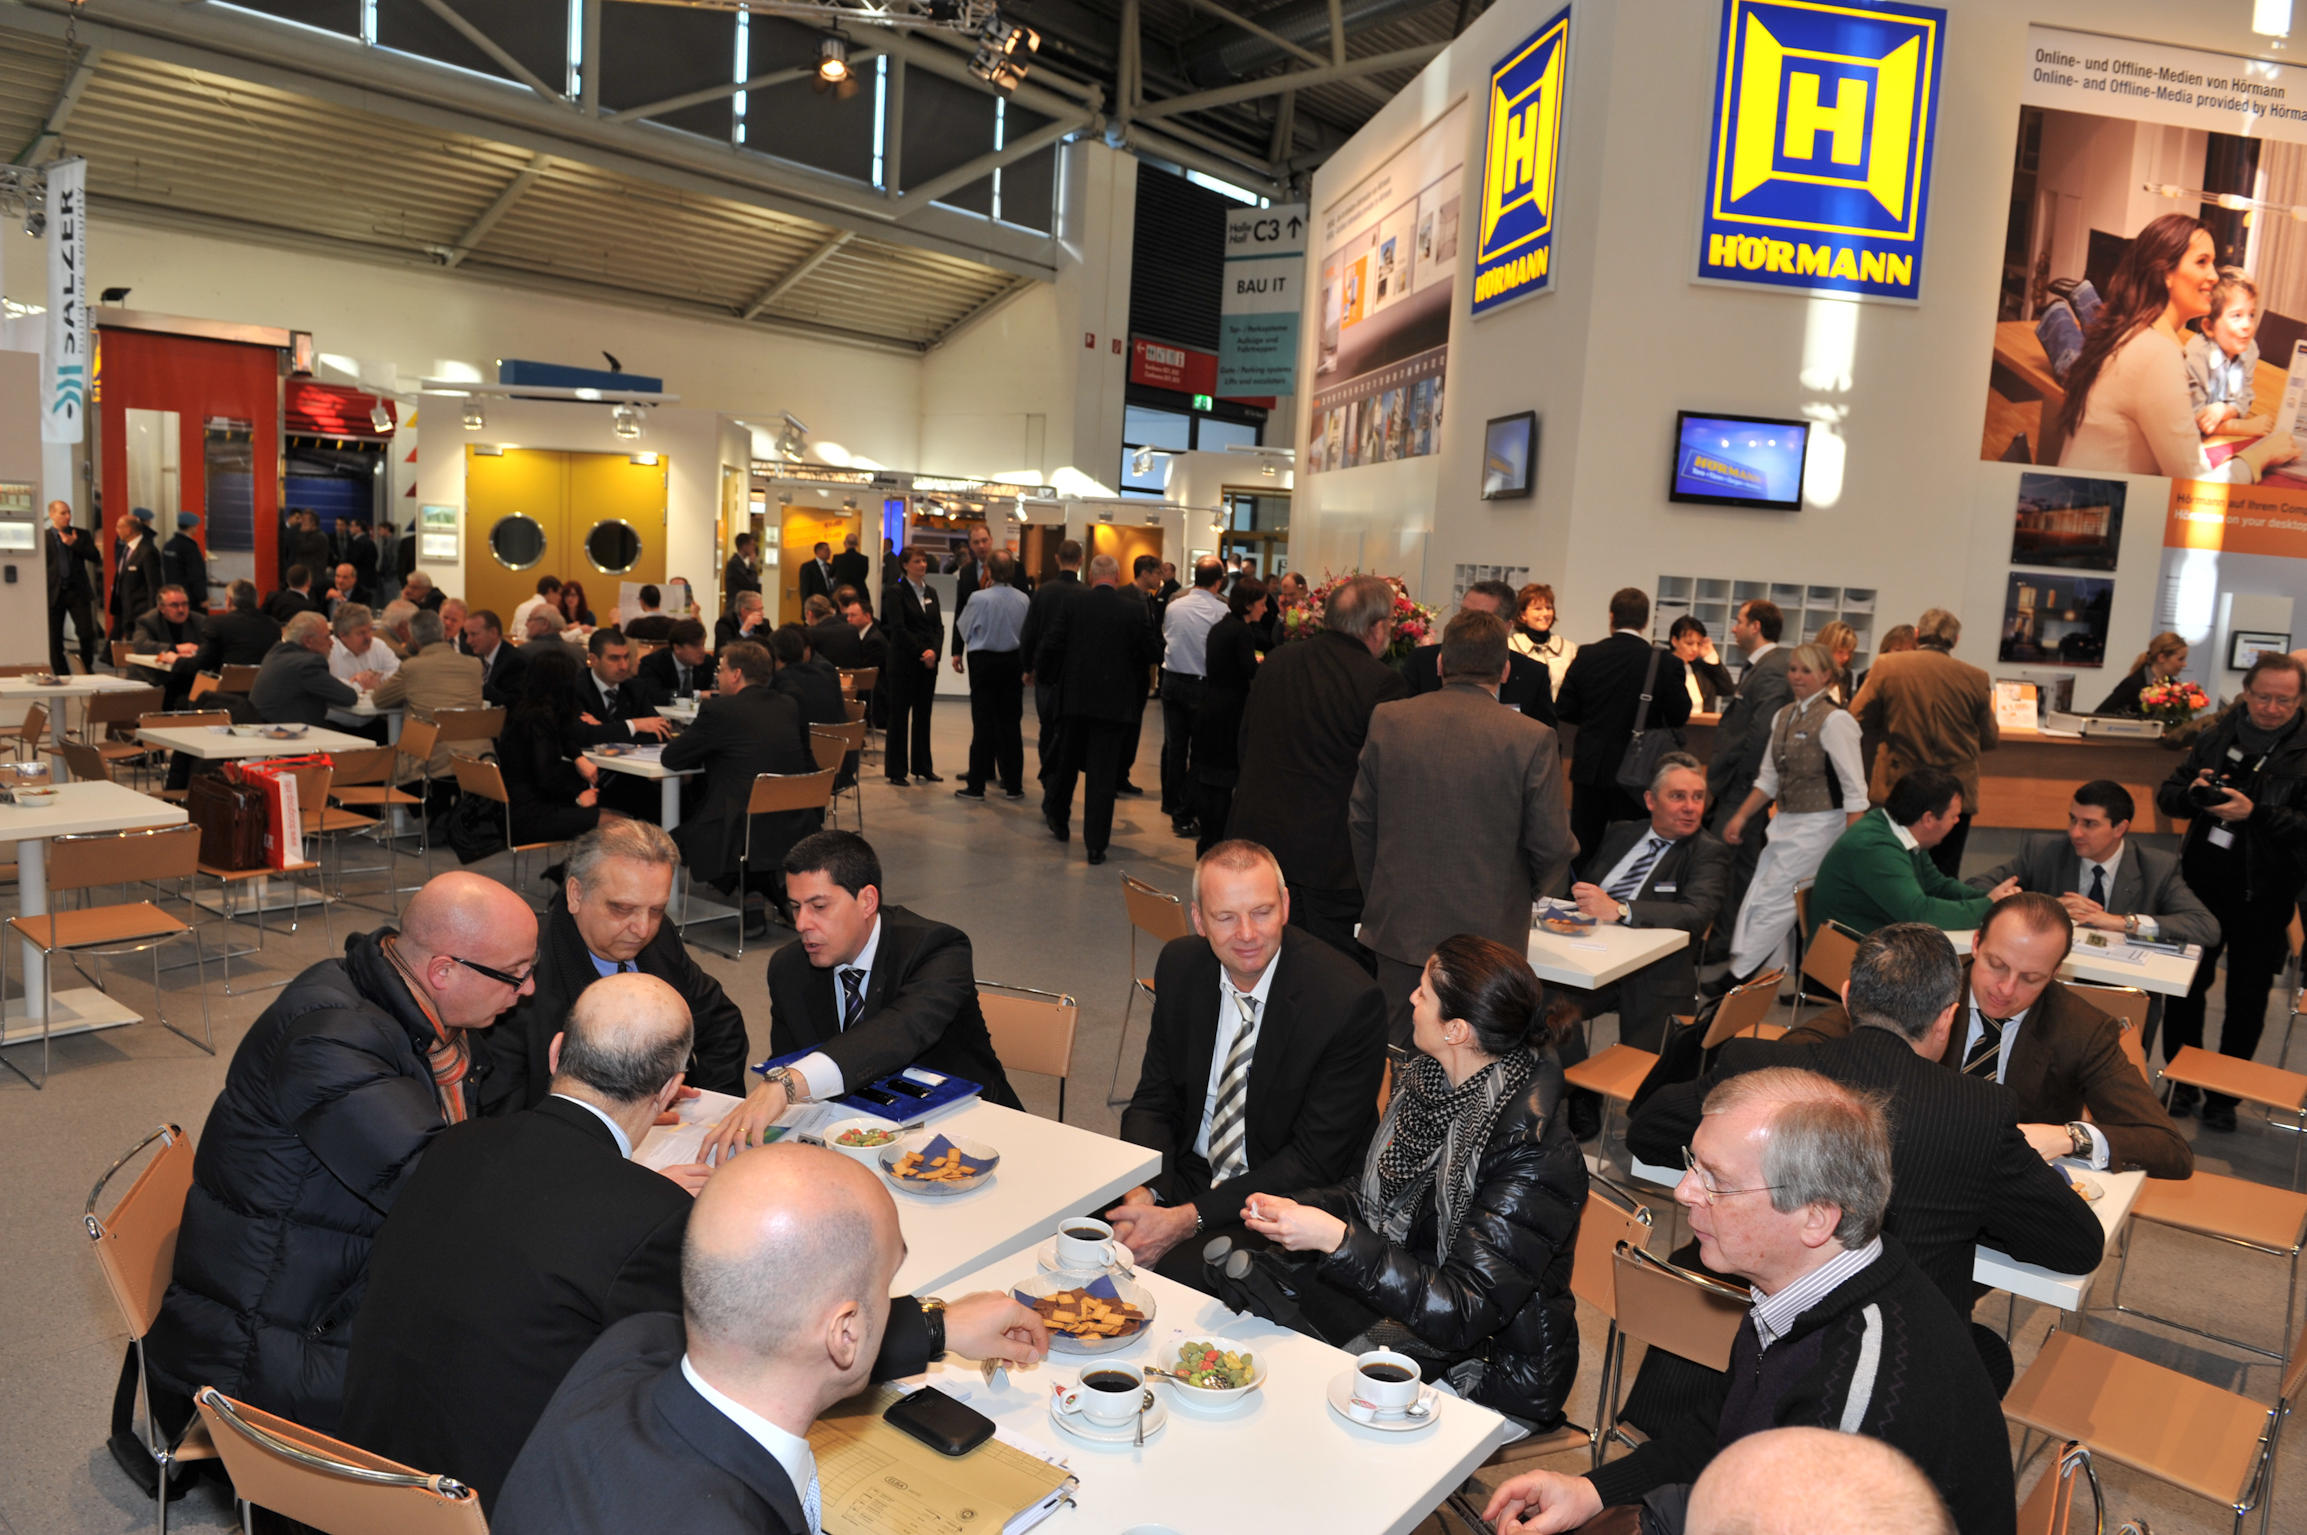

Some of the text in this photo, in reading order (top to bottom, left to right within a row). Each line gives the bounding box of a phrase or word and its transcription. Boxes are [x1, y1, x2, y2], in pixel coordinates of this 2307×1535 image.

[2036, 48, 2286, 99] Online- und Offline-Medien von Hörmann
[2033, 67, 2079, 87] Online-
[2083, 74, 2107, 91] and
[2110, 78, 2193, 105] Offline-Media
[2196, 92, 2249, 112] provided
[2253, 98, 2267, 118] by
[1229, 219, 1280, 242] Halle C3
[1474, 244, 1549, 304] HÖRMANN
[1708, 233, 1913, 286] HÖRMANN
[1237, 277, 1287, 294] BAU IT
[2177, 492, 2226, 506] Hörmann
[2229, 498, 2246, 509] auf
[2248, 499, 2278, 513] Ihrem
[2226, 515, 2240, 525] on
[2241, 516, 2266, 528] your
